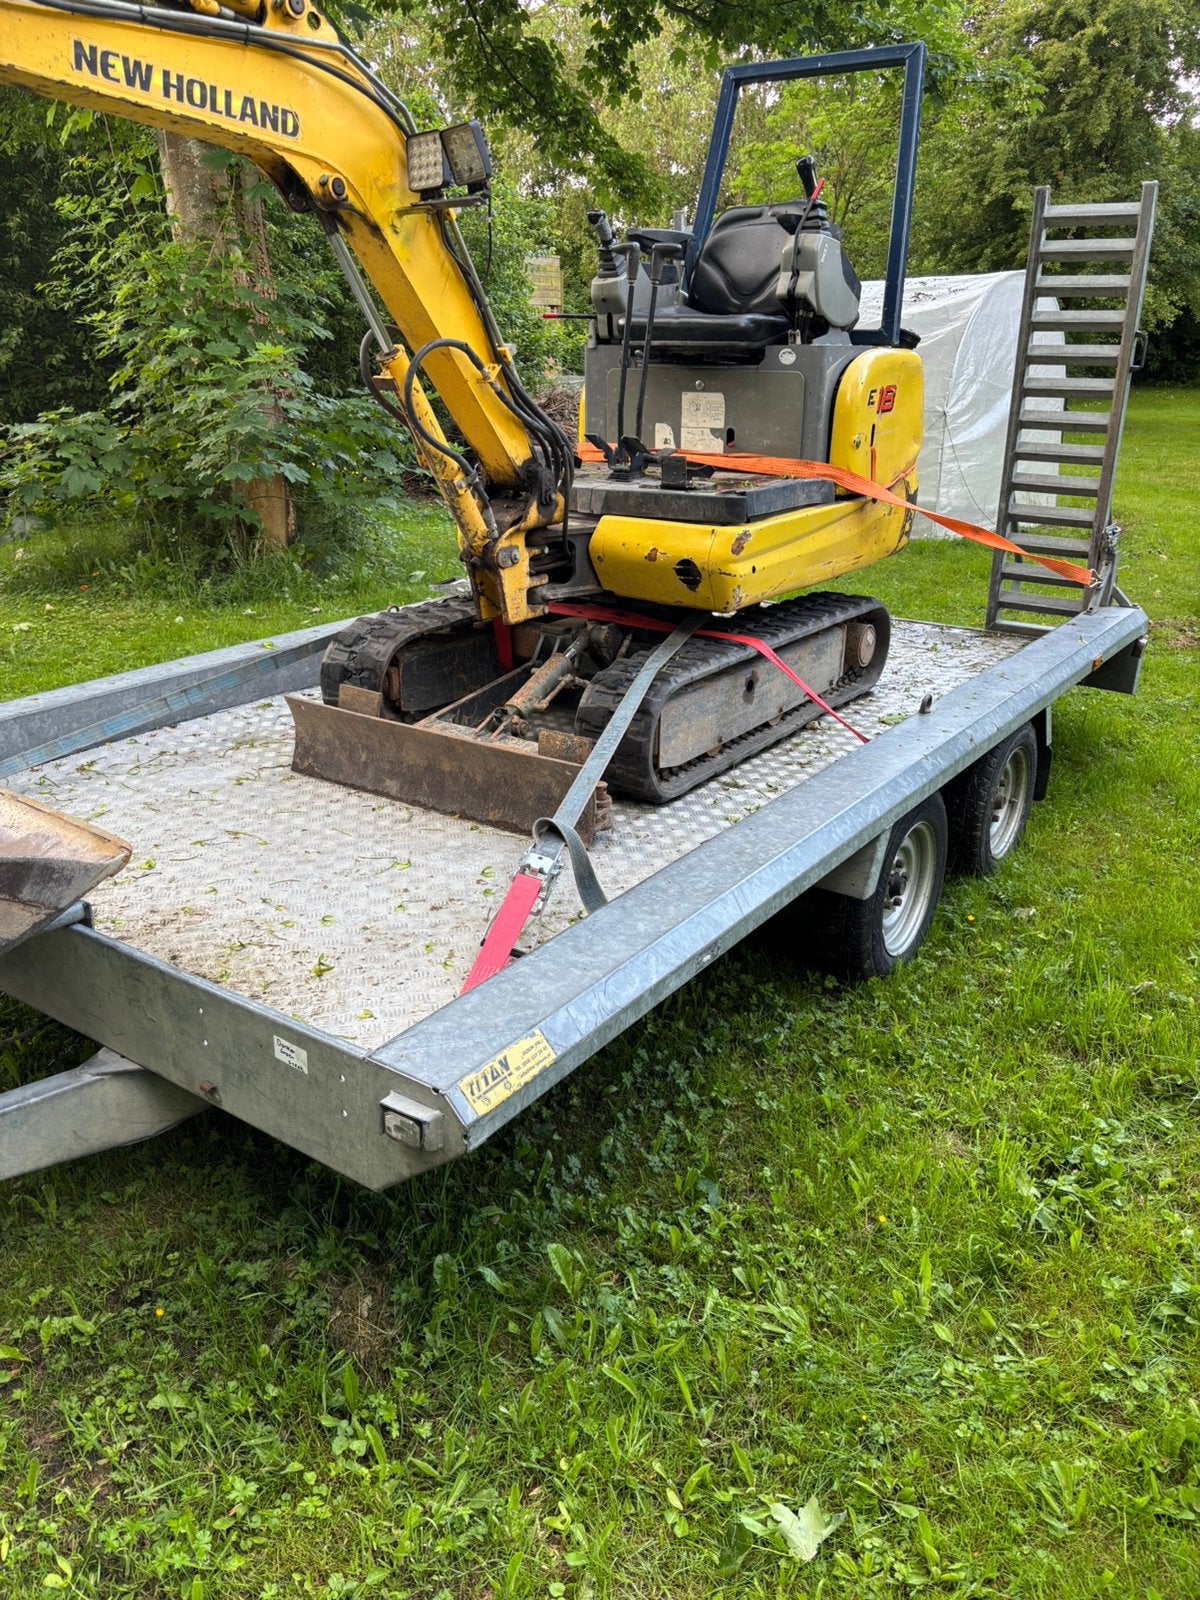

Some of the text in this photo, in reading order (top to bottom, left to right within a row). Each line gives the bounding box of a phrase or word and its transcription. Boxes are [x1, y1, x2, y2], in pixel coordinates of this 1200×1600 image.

[73, 39, 300, 138] NEW HOLLAND
[466, 1054, 511, 1097] TITAN
